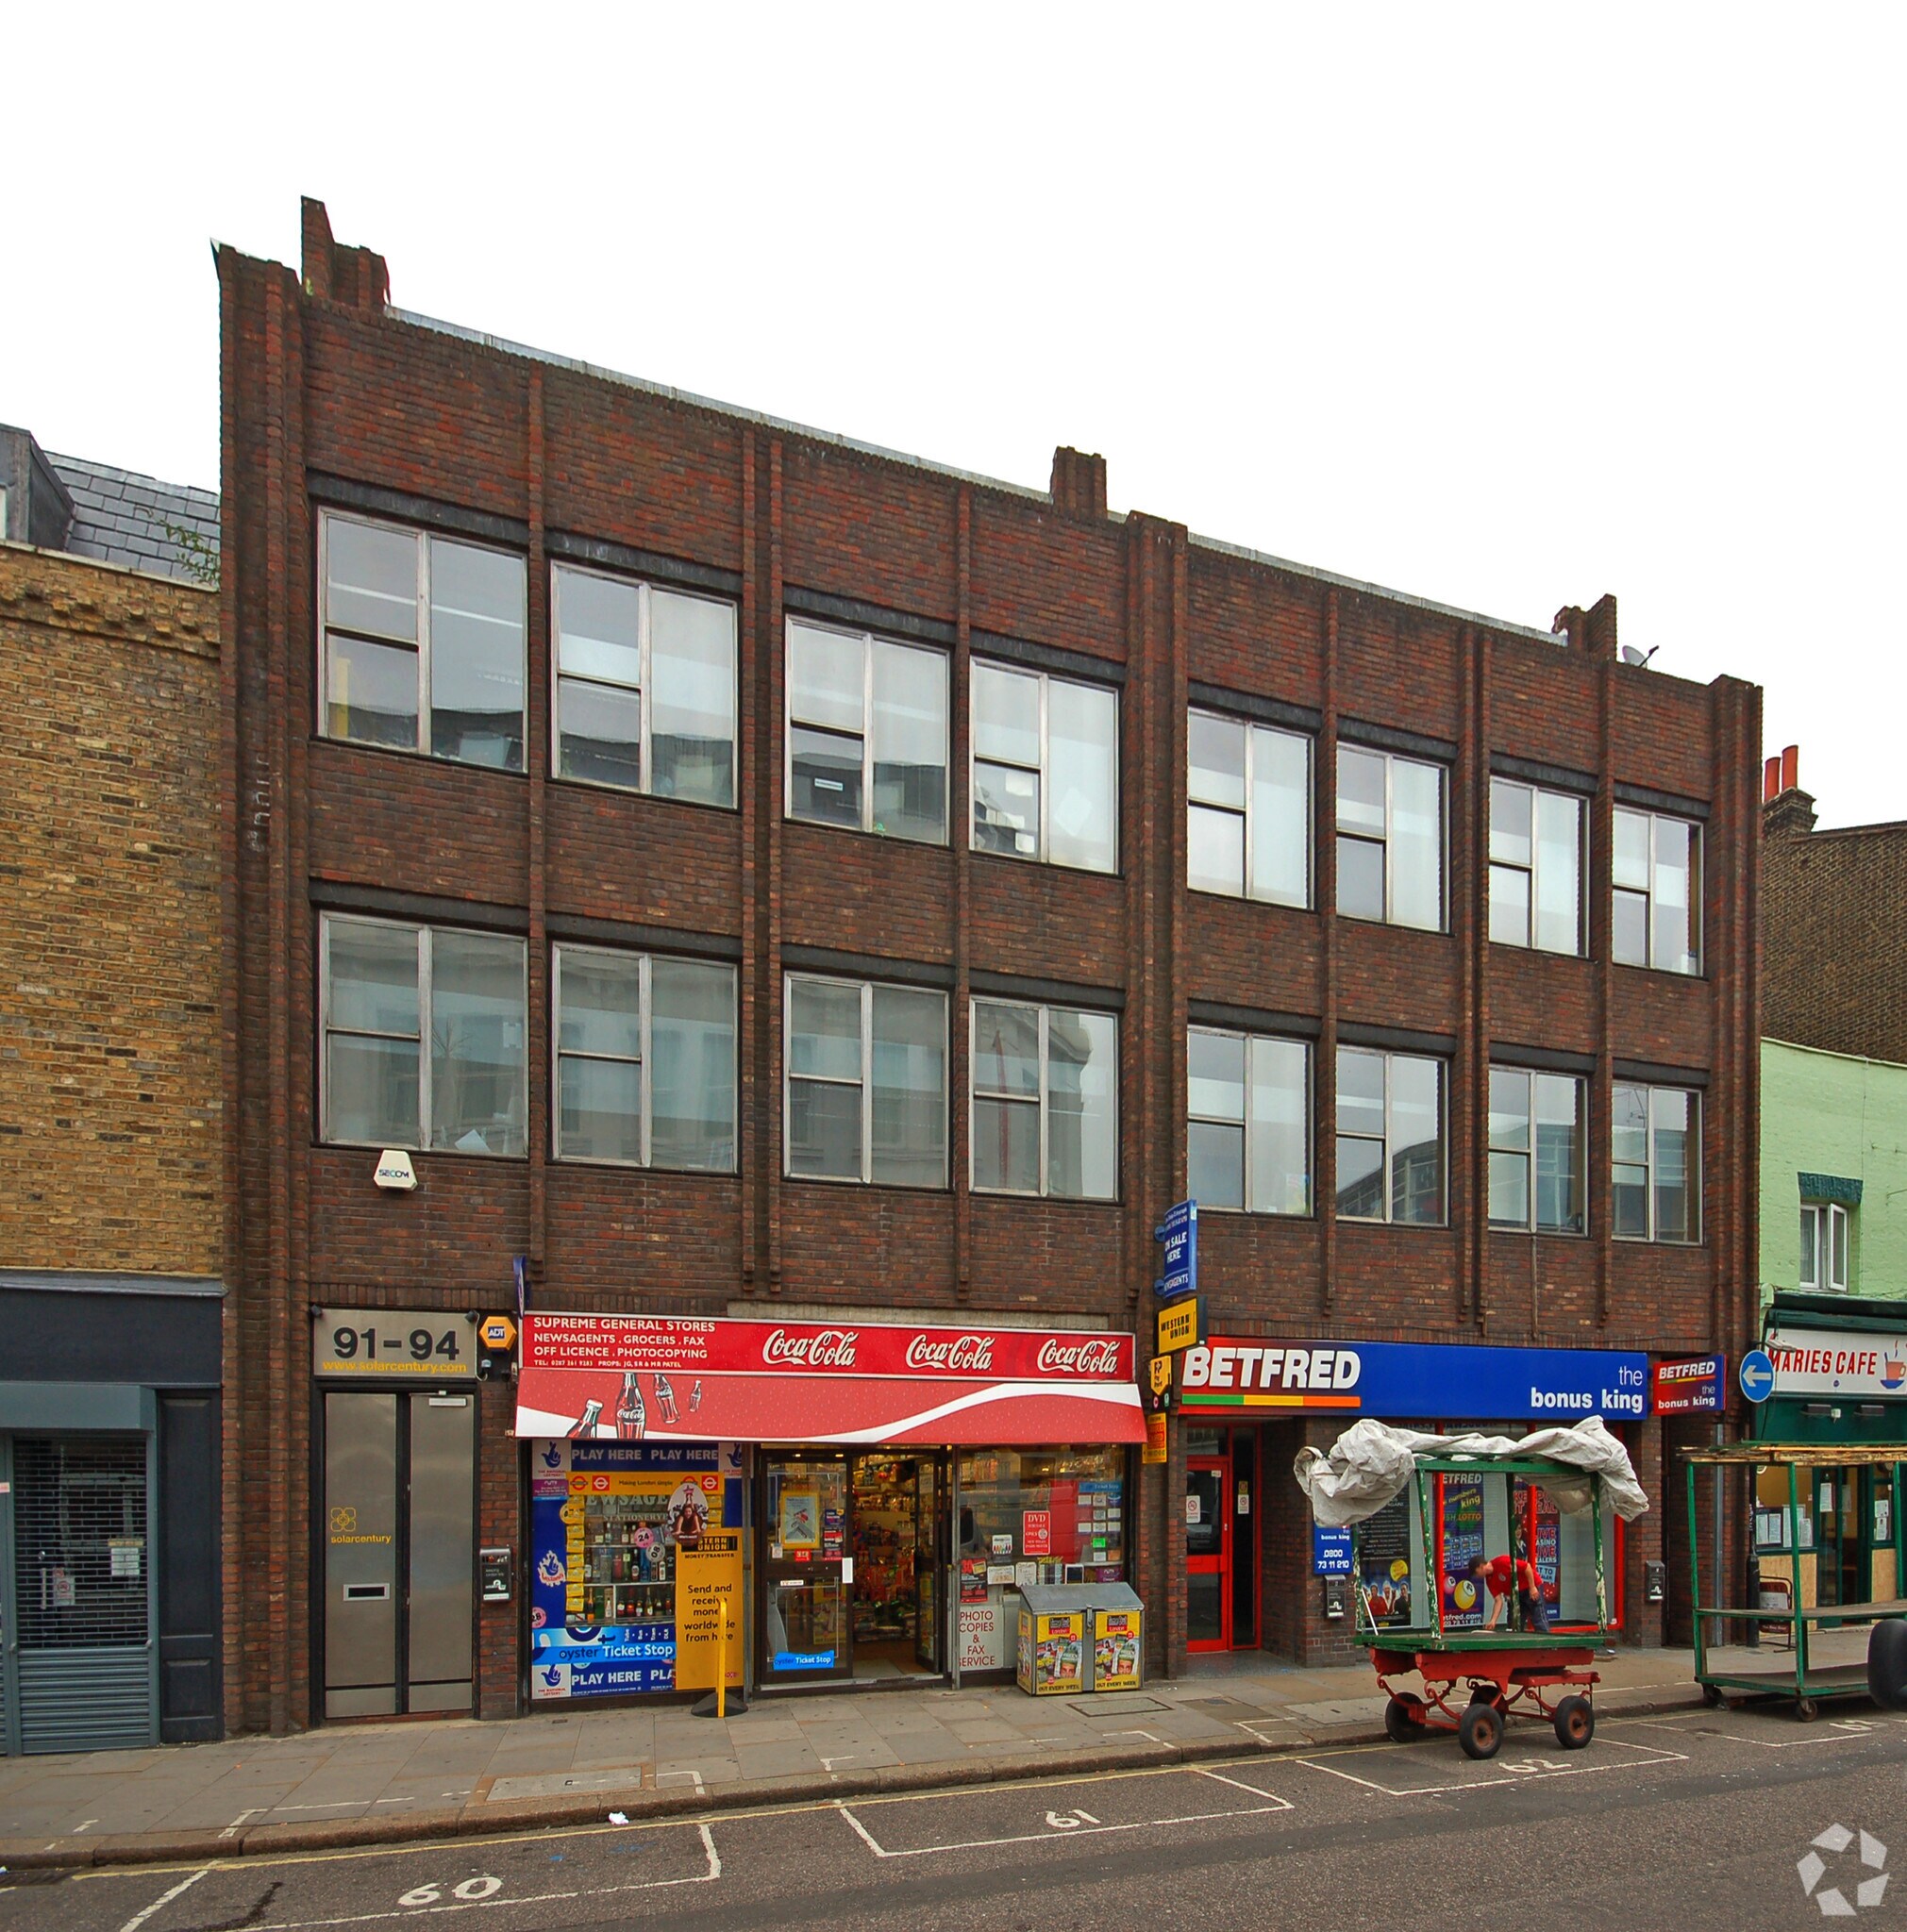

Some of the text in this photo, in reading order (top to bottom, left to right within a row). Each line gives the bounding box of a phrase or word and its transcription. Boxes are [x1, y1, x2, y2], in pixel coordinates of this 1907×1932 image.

[378, 1169, 410, 1178] SECOM
[1171, 1232, 1187, 1247] SALE
[1167, 1248, 1181, 1264] HERE
[533, 1317, 716, 1332] SUPREME GENERAL STORES
[1161, 1314, 1189, 1332] WESTERN
[488, 1327, 505, 1338] ADT
[1170, 1324, 1189, 1340] UNION
[533, 1333, 705, 1346] NEWSAGENTS GROCERS FAX
[533, 1346, 708, 1358] OFF LICENCE PHOTOCOPYING
[323, 1360, 467, 1374] www.solarcentury.com
[1767, 1348, 1878, 1375] MARIES CAFE
[1182, 1346, 1362, 1390] BETFRED
[1658, 1360, 1715, 1380] BETFRED
[1618, 1366, 1643, 1386] the
[1701, 1385, 1715, 1394] the
[1531, 1387, 1643, 1413] bonus king
[1658, 1396, 1715, 1409] bonus king
[571, 1449, 719, 1460] PLAY HERE PLAY HERE
[1443, 1473, 1482, 1485] ETFRED
[1461, 1494, 1480, 1508] king
[1028, 1514, 1046, 1523] DVD
[638, 1532, 649, 1542] 24
[1536, 1527, 1557, 1539] IVE
[330, 1535, 392, 1544] solarcentury
[1536, 1546, 1557, 1557] IVE
[1317, 1559, 1349, 1569] 73 11 210
[688, 1584, 732, 1593] Send and
[960, 1610, 994, 1621] PHOTO
[684, 1620, 735, 1630] worldwde
[959, 1622, 995, 1633] COPIES
[686, 1632, 733, 1641] from hre
[972, 1634, 979, 1643] &
[560, 1643, 673, 1662] oyster Ticket Stop
[967, 1645, 985, 1655] FAX
[815, 1656, 831, 1665] Stop
[571, 1669, 673, 1687] PLAY HERE PLA
[1498, 1758, 1572, 1773] 62
[1046, 1809, 1100, 1828] 61
[397, 1876, 503, 1906] 60
